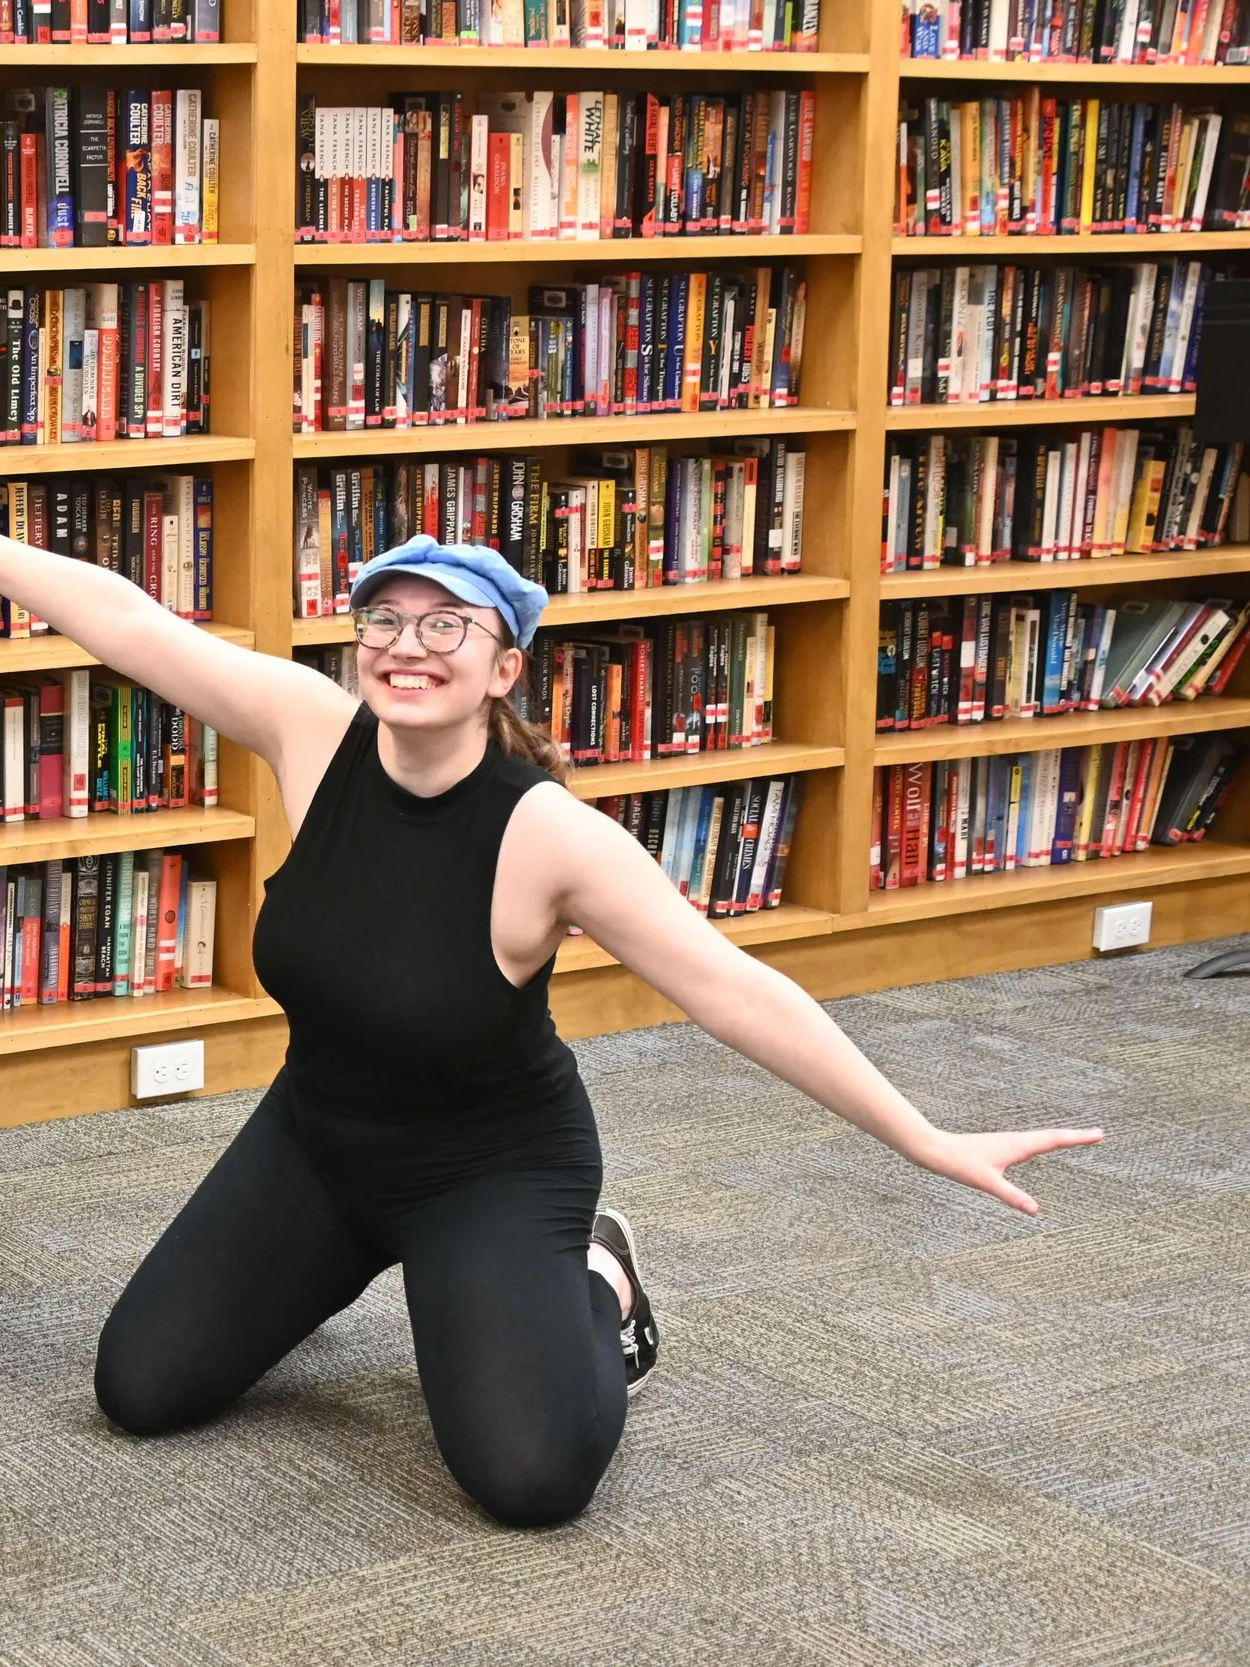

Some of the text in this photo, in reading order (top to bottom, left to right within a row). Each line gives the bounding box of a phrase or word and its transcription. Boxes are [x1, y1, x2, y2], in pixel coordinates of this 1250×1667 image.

[130, 103, 140, 145] COULTER
[140, 103, 148, 144] CATHERINE
[153, 104, 163, 145] COULTER
[164, 104, 172, 144] CATHERINE
[188, 94, 197, 177] CATHERINE COULTER
[584, 106, 595, 154] WHITE
[594, 100, 602, 146] LETHAL
[55, 139, 70, 195] CORNWELL
[136, 172, 146, 198] BACK
[57, 202, 68, 227] dust
[153, 304, 161, 372] FOREIGN COUNTRY
[677, 300, 685, 341] GRAFTON
[8, 339, 21, 423] The Old Limey
[171, 318, 182, 408] AMERICAN DIRT
[28, 407, 36, 423] Spy
[134, 374, 144, 419] DIVIDED SPY
[14, 487, 24, 519] JEFFERY
[336, 474, 346, 511] Griffin
[351, 471, 360, 507] Griffin
[446, 468, 456, 498] JAMES
[510, 461, 525, 541] JOHN GRISHAM
[529, 464, 540, 524] THE FIRM
[638, 474, 648, 512] GRISHAM
[34, 498, 42, 546] JEFFERY
[56, 493, 68, 539] ADAM
[150, 517, 158, 546] RING
[491, 492, 499, 534] GRIPPANDO
[603, 520, 611, 546] GRISHAM
[638, 644, 646, 670] ROBERT
[916, 611, 928, 668] ROBERT LUDLUM
[632, 800, 642, 824] JACK
[748, 794, 761, 824] SOCIAL
[763, 788, 783, 851] TAMI HOAG
[742, 839, 755, 870] CRIMES
[105, 862, 113, 902] JENNIFER
[147, 897, 158, 949] WORST HARD
